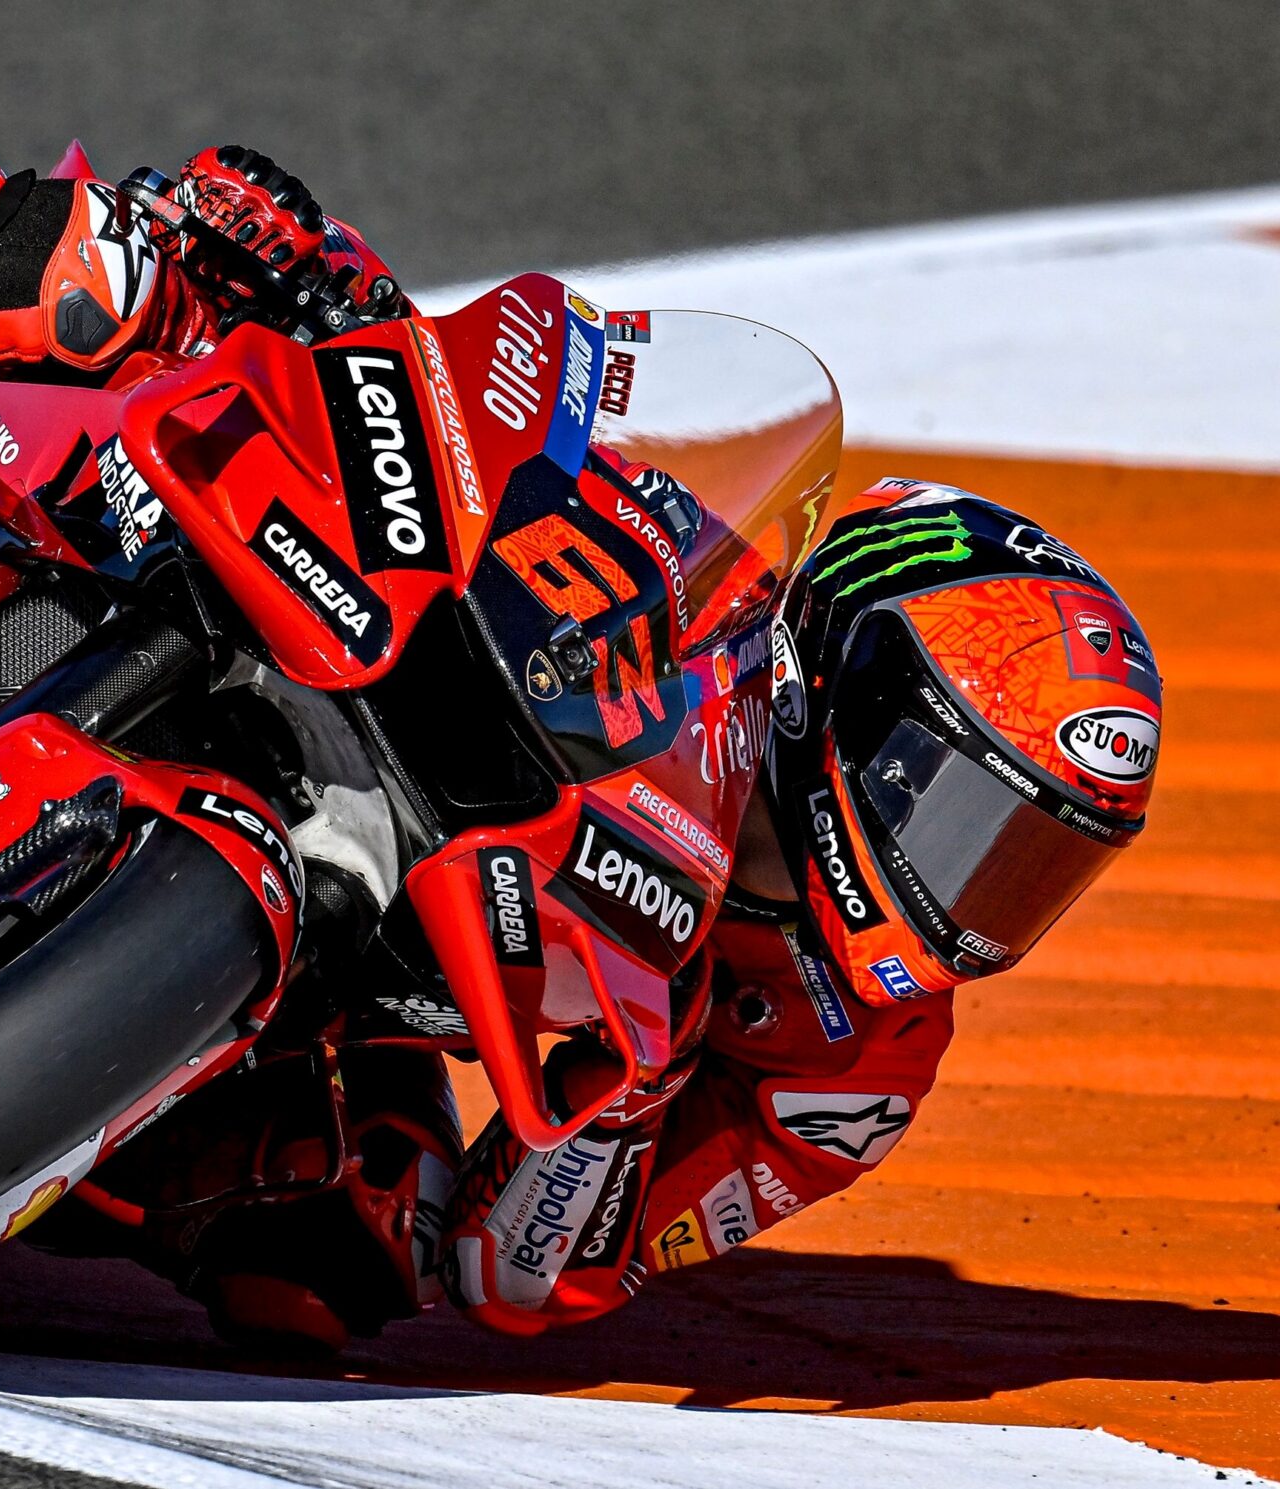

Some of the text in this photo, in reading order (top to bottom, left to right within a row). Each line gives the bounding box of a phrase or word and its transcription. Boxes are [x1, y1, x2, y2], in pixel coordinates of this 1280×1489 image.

[419, 325, 485, 517] FRECCIAROSSA
[562, 319, 593, 426] ADVANCE
[599, 349, 636, 417] PECCO
[97, 446, 143, 562] INDUSTRIE
[346, 356, 426, 555] Lenovo
[264, 522, 372, 638] CARRERA
[615, 497, 688, 633] VARGROUP
[492, 513, 667, 749] 63
[1078, 616, 1107, 628] DUCATI
[1123, 632, 1156, 664] Leno
[921, 687, 970, 736] SUOMY
[1075, 718, 1159, 778] SUOMY
[983, 751, 1041, 799] CARRERA
[628, 782, 730, 874] FRECCIAROSSA
[807, 787, 867, 919] Lenovo
[1071, 811, 1114, 837] MONSTER
[490, 856, 529, 953] CARRERA
[573, 824, 695, 942] Lenovo
[801, 954, 841, 1028] MICHELIN
[962, 934, 1004, 958] FASSI
[496, 1178, 541, 1261] ASSICURAZIONI
[509, 1137, 607, 1279] UnipolSai
[582, 1139, 654, 1259] Lenovo
